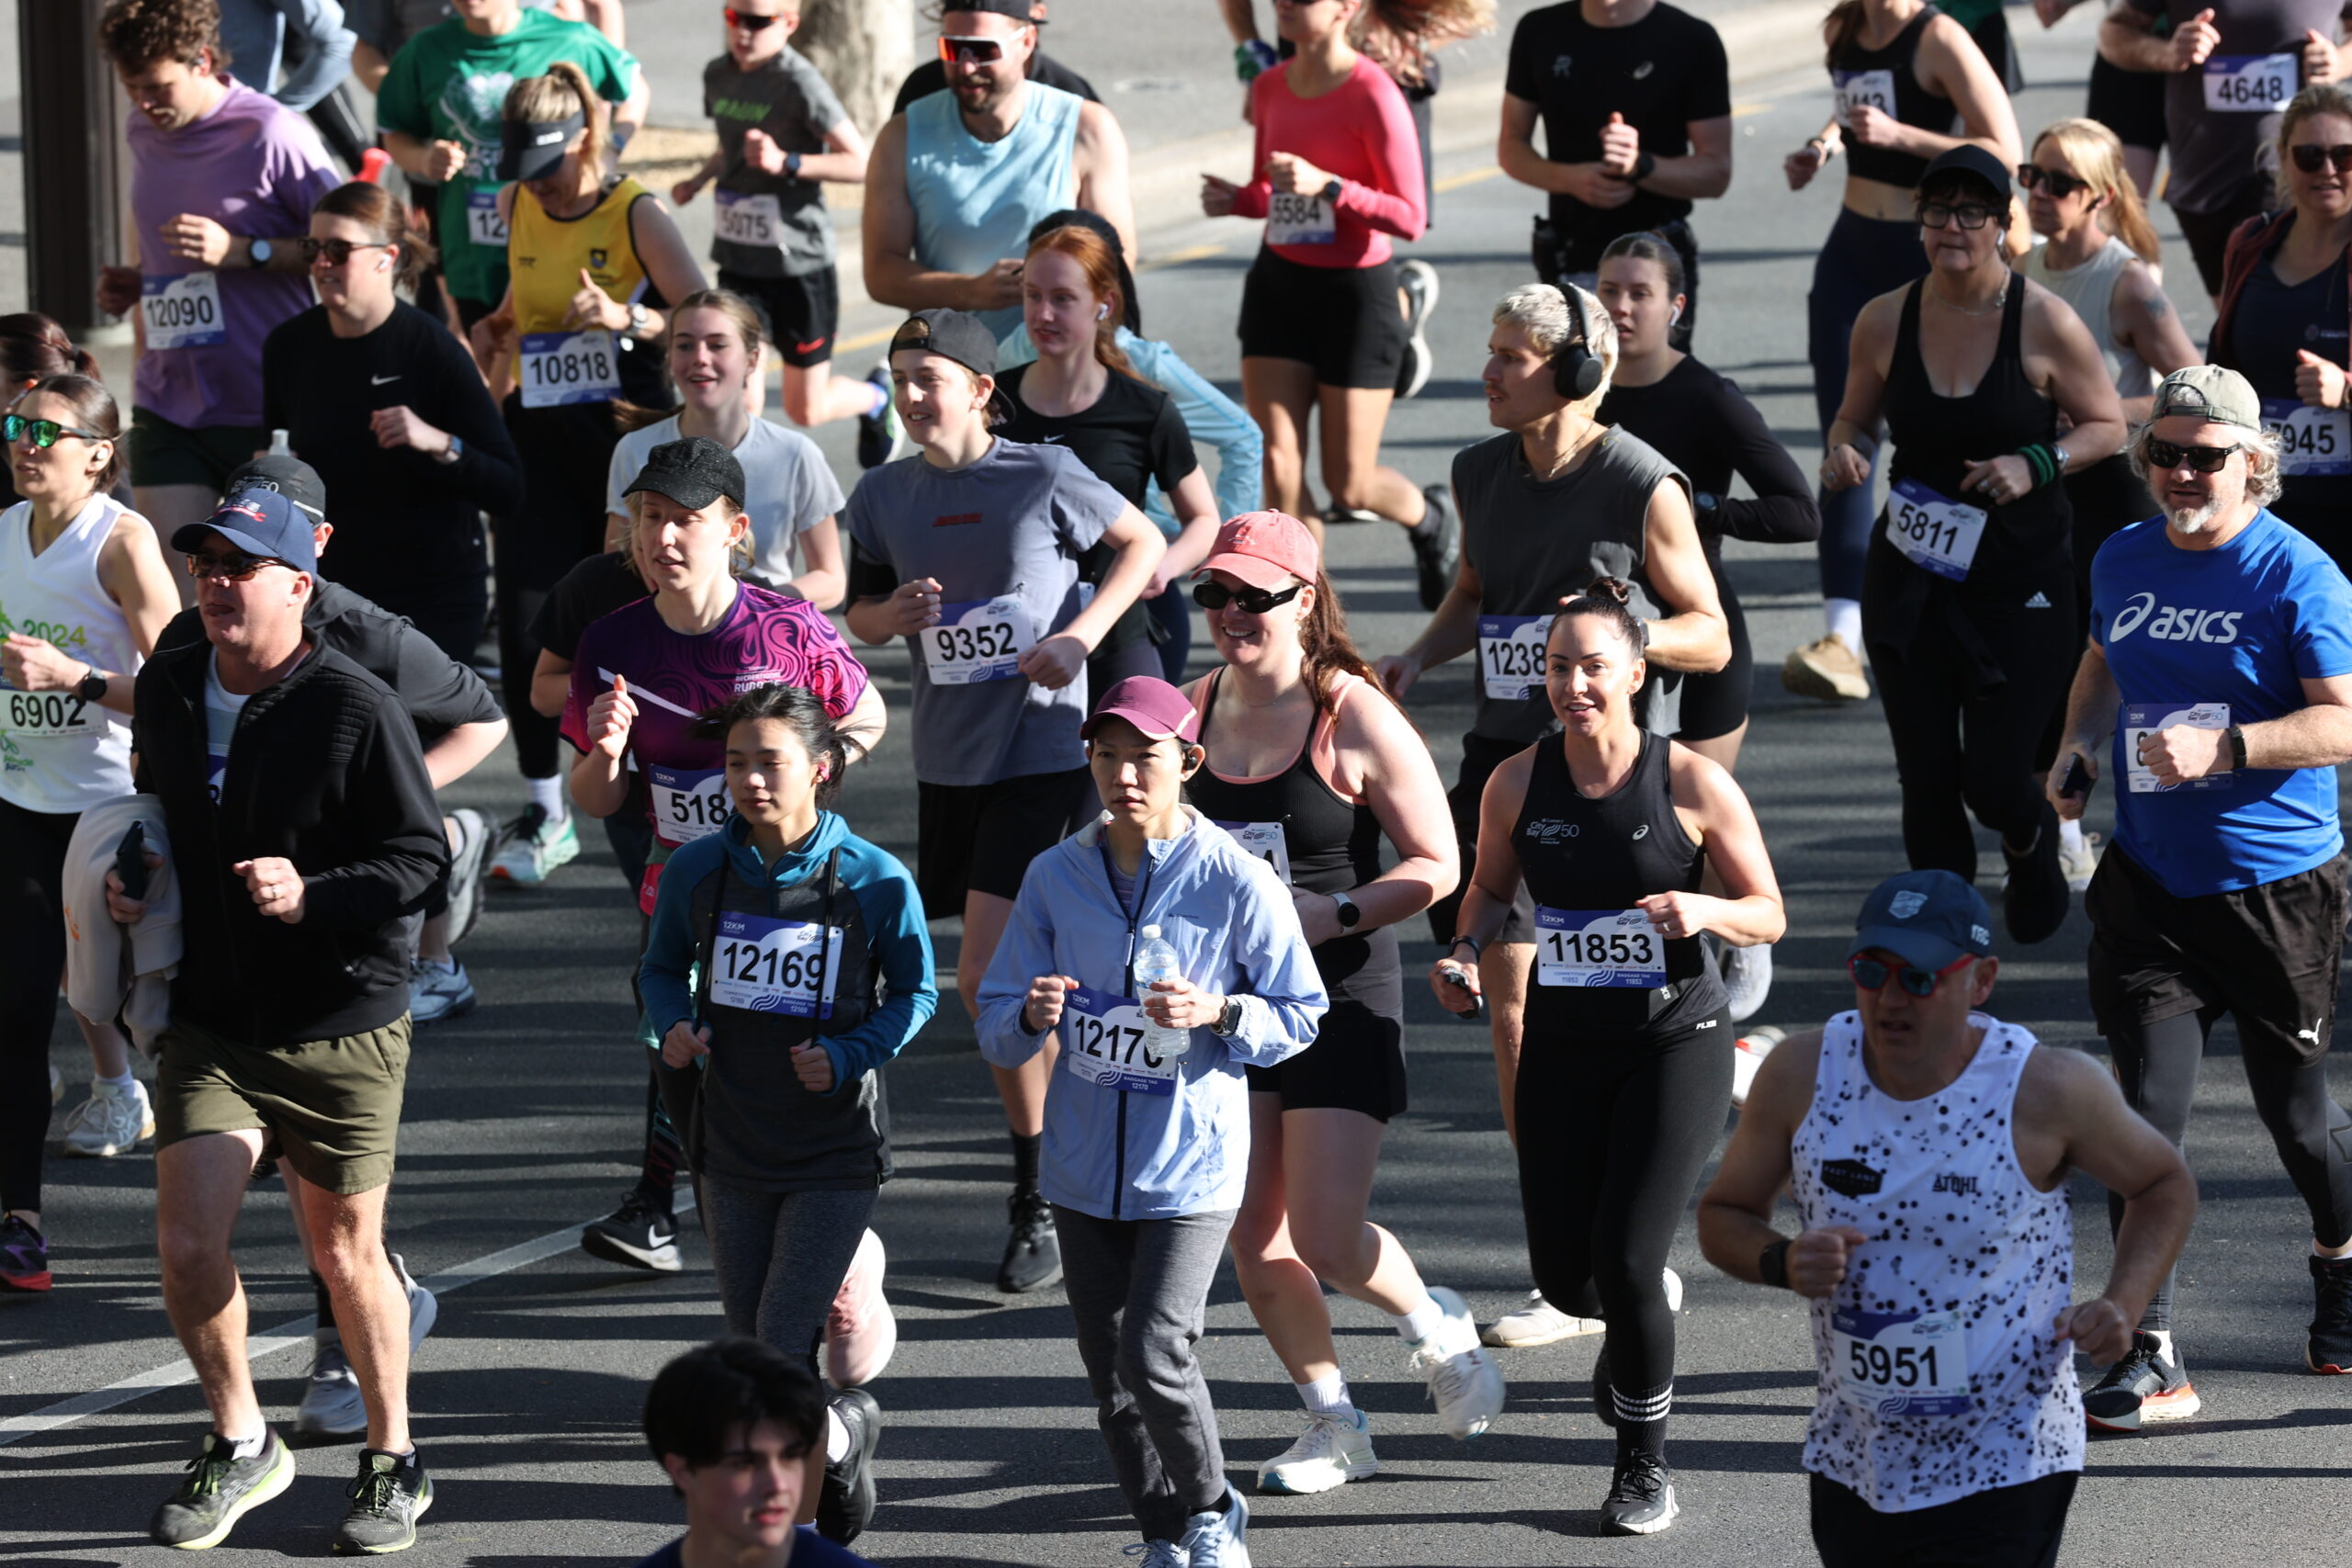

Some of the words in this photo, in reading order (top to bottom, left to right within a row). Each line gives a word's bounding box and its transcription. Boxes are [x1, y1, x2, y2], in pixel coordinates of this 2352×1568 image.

[2218, 76, 2283, 103] 4648
[146, 295, 213, 328] 12090
[530, 352, 609, 385] 10818
[1897, 502, 1959, 555] 5811
[936, 622, 1018, 661] 9352
[1488, 641, 1547, 677] 1238
[10, 694, 86, 728] 6902
[1526, 828, 1541, 838] Bay
[1530, 821, 1545, 829] City
[1560, 824, 1580, 838] 50
[722, 920, 745, 931] 12KM
[1542, 915, 1564, 923] 12KM
[1547, 932, 1653, 964] 11853
[723, 942, 825, 992] 12169
[1073, 994, 1090, 1005] 12KM
[1132, 1082, 1148, 1090] 12170
[1850, 1340, 1938, 1387] 5951
